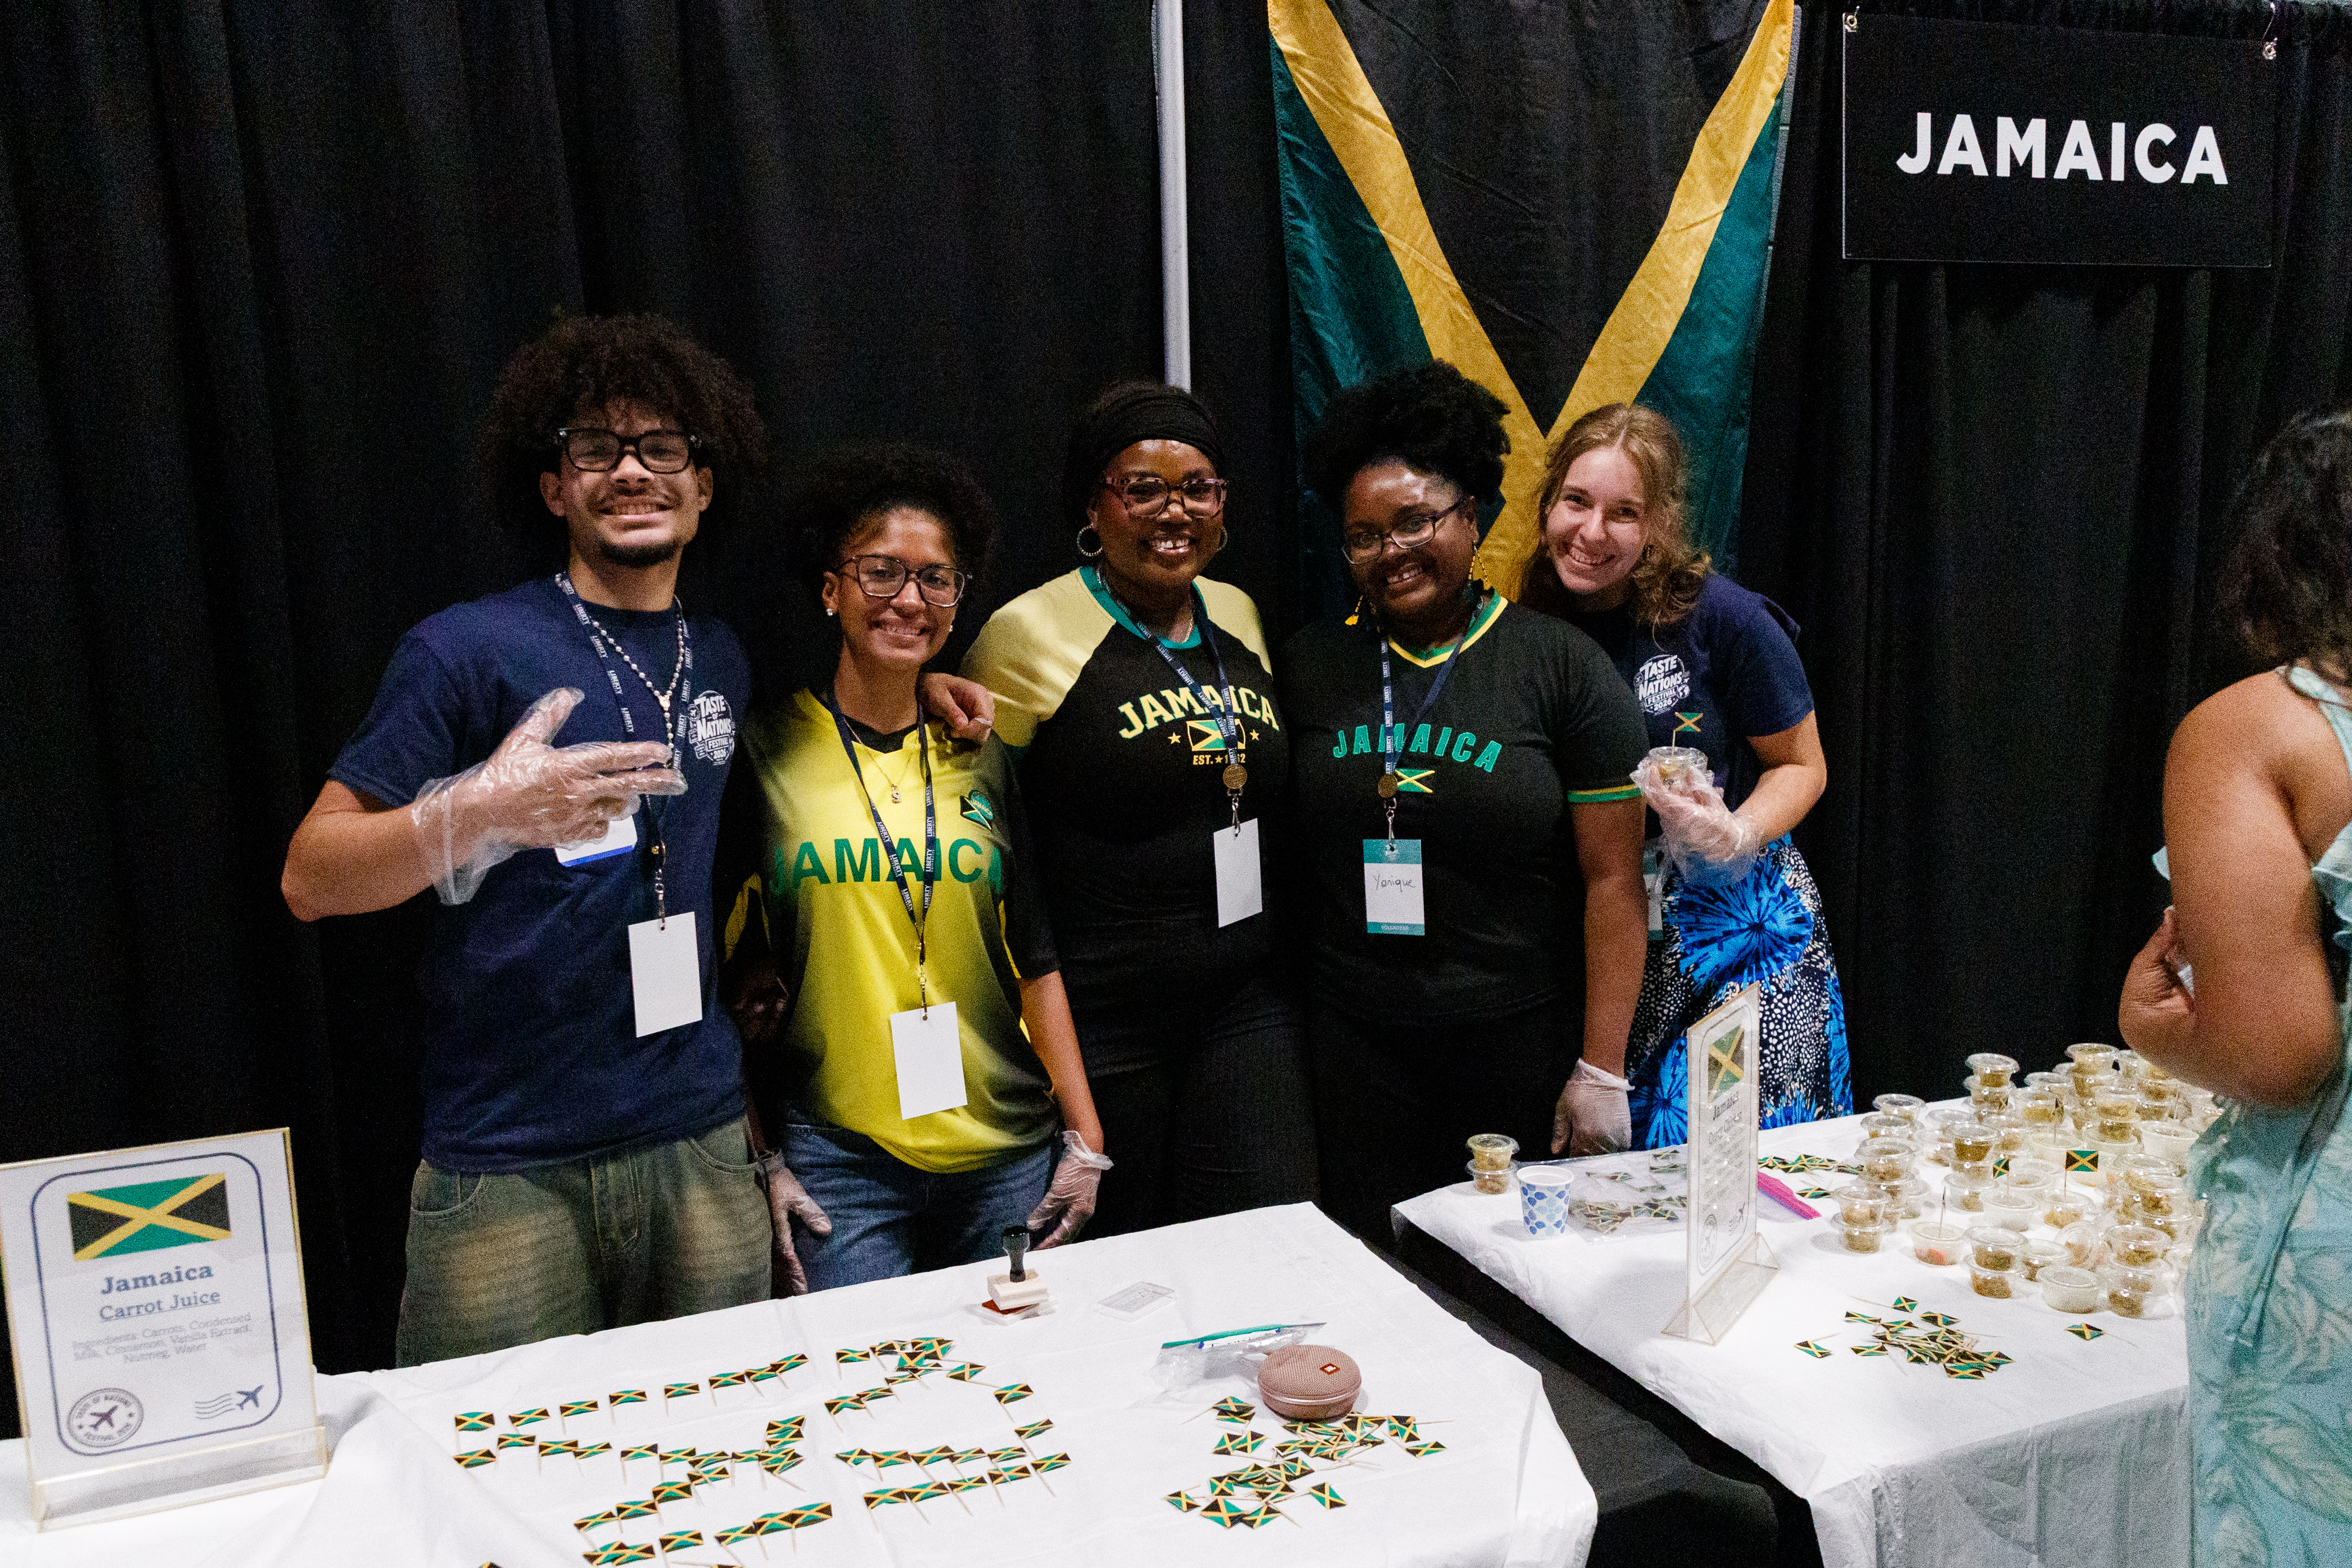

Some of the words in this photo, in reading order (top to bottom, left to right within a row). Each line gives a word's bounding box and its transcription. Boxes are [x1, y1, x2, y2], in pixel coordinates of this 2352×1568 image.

[1896, 112, 2228, 185] JAMAICA
[576, 604, 591, 625] LIBERTY
[592, 635, 608, 658] LIBERTY
[1157, 645, 1172, 662] LIBERTY
[1177, 667, 1193, 685] LIBERTY
[1640, 654, 1678, 681] TASTE
[609, 670, 623, 695] LIBERTY
[681, 679, 690, 702] LIBERTY
[1639, 671, 1683, 701] NATIONS
[693, 695, 726, 717] TASTE
[1224, 688, 1232, 706] LIBERTY
[1648, 688, 1676, 704] FESTIVAL
[1654, 697, 1673, 711] 2026
[623, 707, 634, 733] LIBERTY
[1118, 685, 1280, 739] JAMAICA
[678, 713, 686, 736] LIBERTY
[697, 718, 732, 742] NATIONS
[708, 737, 729, 749] FESTIVAL
[1333, 723, 1502, 773] JAMAICA
[673, 748, 681, 769] IBERTY
[1193, 754, 1214, 765] EST.
[877, 821, 891, 842] LIBERTY
[891, 853, 903, 877] LIBERTY
[903, 889, 912, 911] LIBERTY
[101, 1266, 214, 1295] Jamaica
[99, 1299, 163, 1321] Carrot
[169, 1291, 221, 1310] Juice
